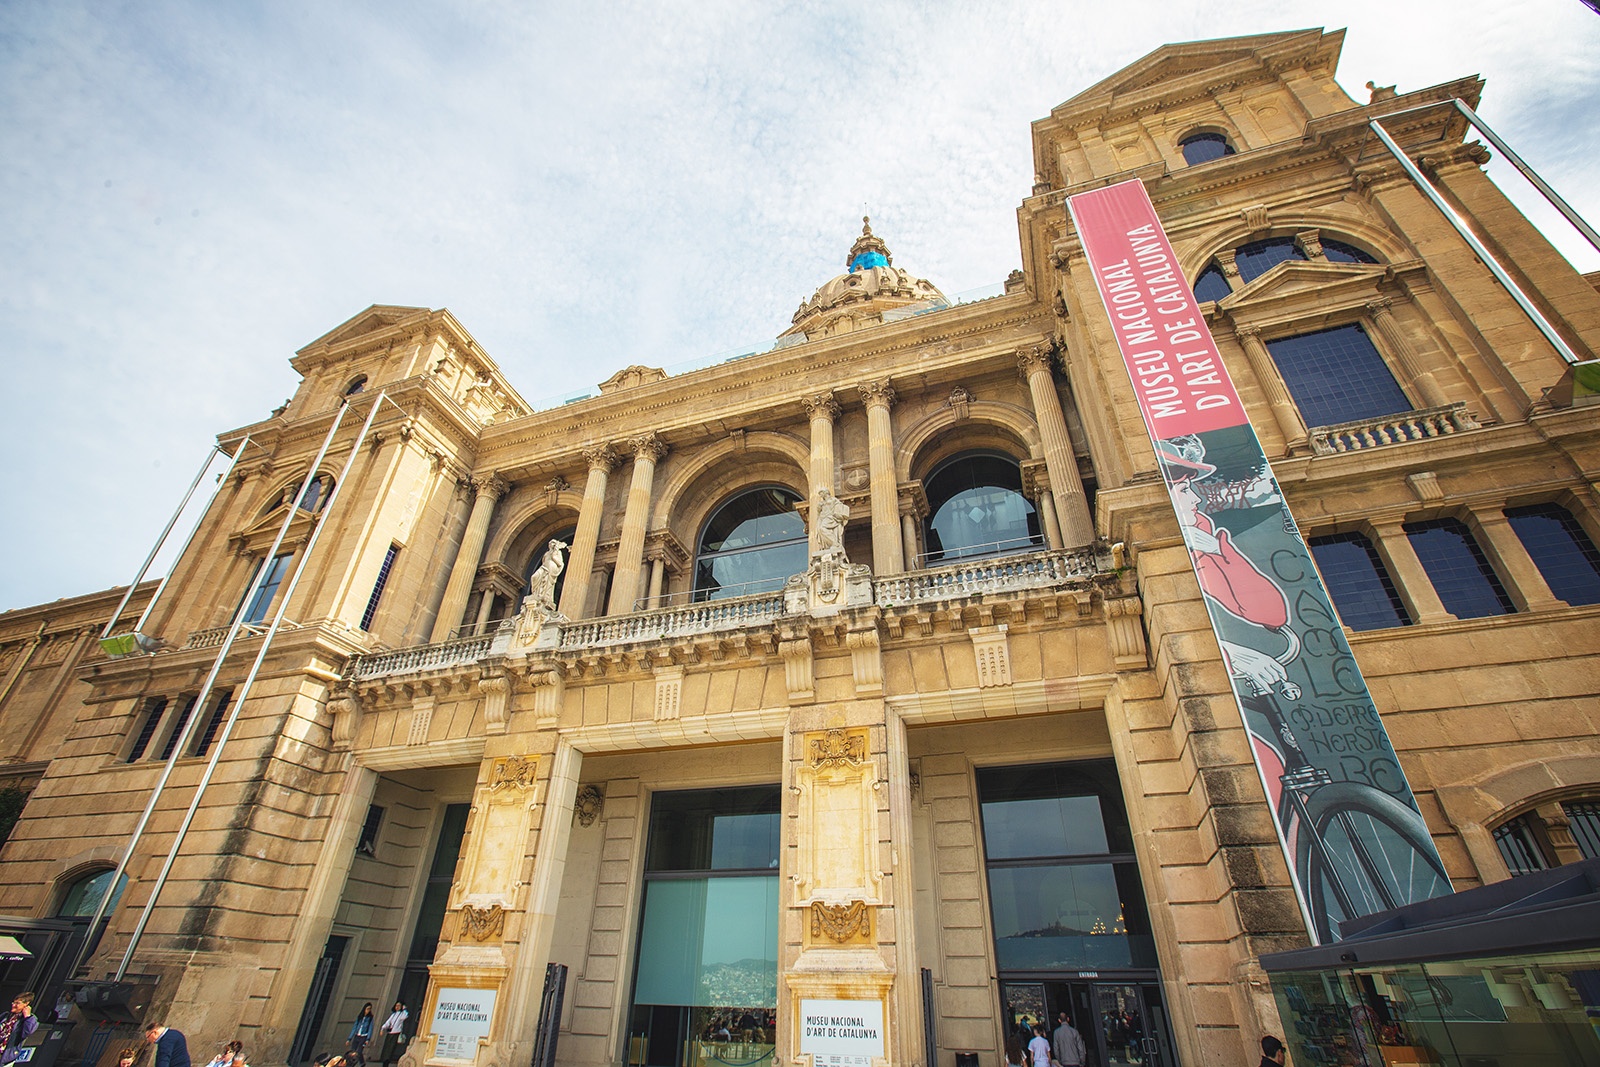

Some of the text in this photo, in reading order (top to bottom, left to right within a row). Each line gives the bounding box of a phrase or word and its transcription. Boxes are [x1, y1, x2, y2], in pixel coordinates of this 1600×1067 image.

[1126, 223, 1231, 411] D'ART DE CATALUNYA
[1101, 258, 1187, 419] MUSEU NACIONAL
[439, 1001, 481, 1012] MUSEU NACIONAL
[437, 1012, 488, 1022] D'ART DE CATALUNYA
[806, 1016, 865, 1027] MUSEU NACIONAL
[806, 1028, 878, 1039] D'ART DE CATALUNYA
